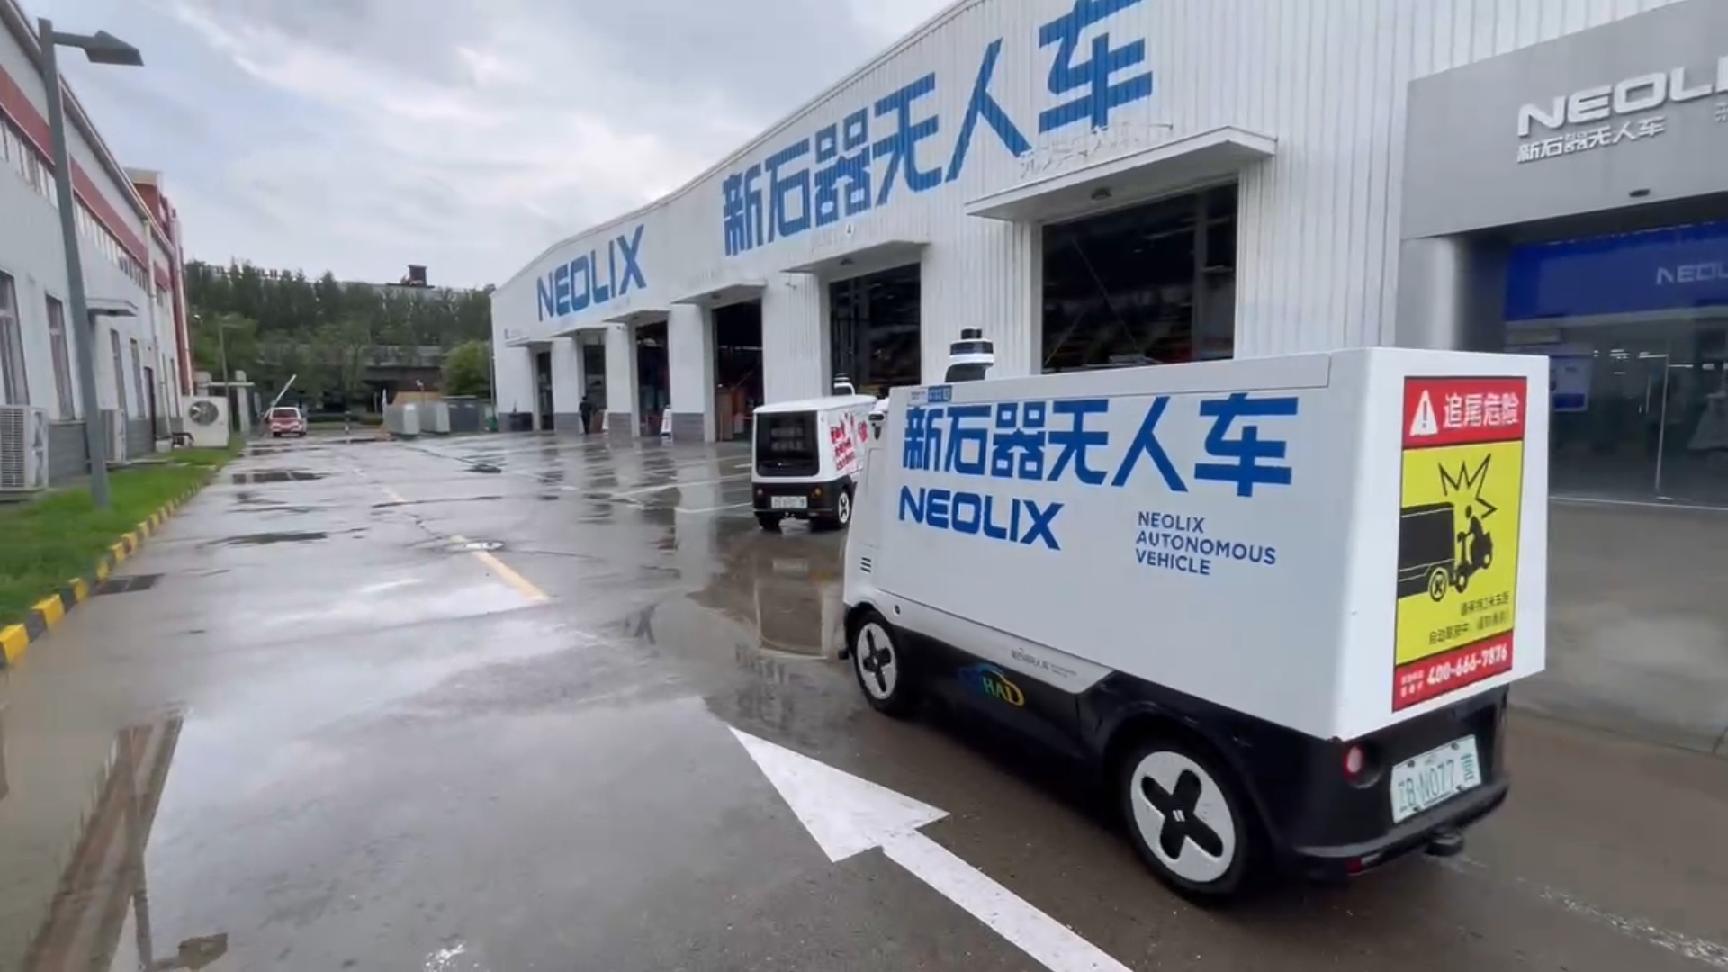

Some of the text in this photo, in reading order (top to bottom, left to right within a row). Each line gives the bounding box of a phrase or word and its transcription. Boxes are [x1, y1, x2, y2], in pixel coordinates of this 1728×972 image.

[723, 0, 1154, 257] 新石器无人车
[1516, 115, 1666, 163] 新石器无人车
[536, 225, 647, 322] NEOLIX
[1443, 391, 1519, 428] 追尾危险
[903, 392, 1299, 498] 新石器无人车
[898, 485, 1066, 551] NEOLIX
[1138, 511, 1205, 534] NEOLIX
[1135, 531, 1277, 566] AUTONOMOUS
[1135, 548, 1211, 576] VEHICLE
